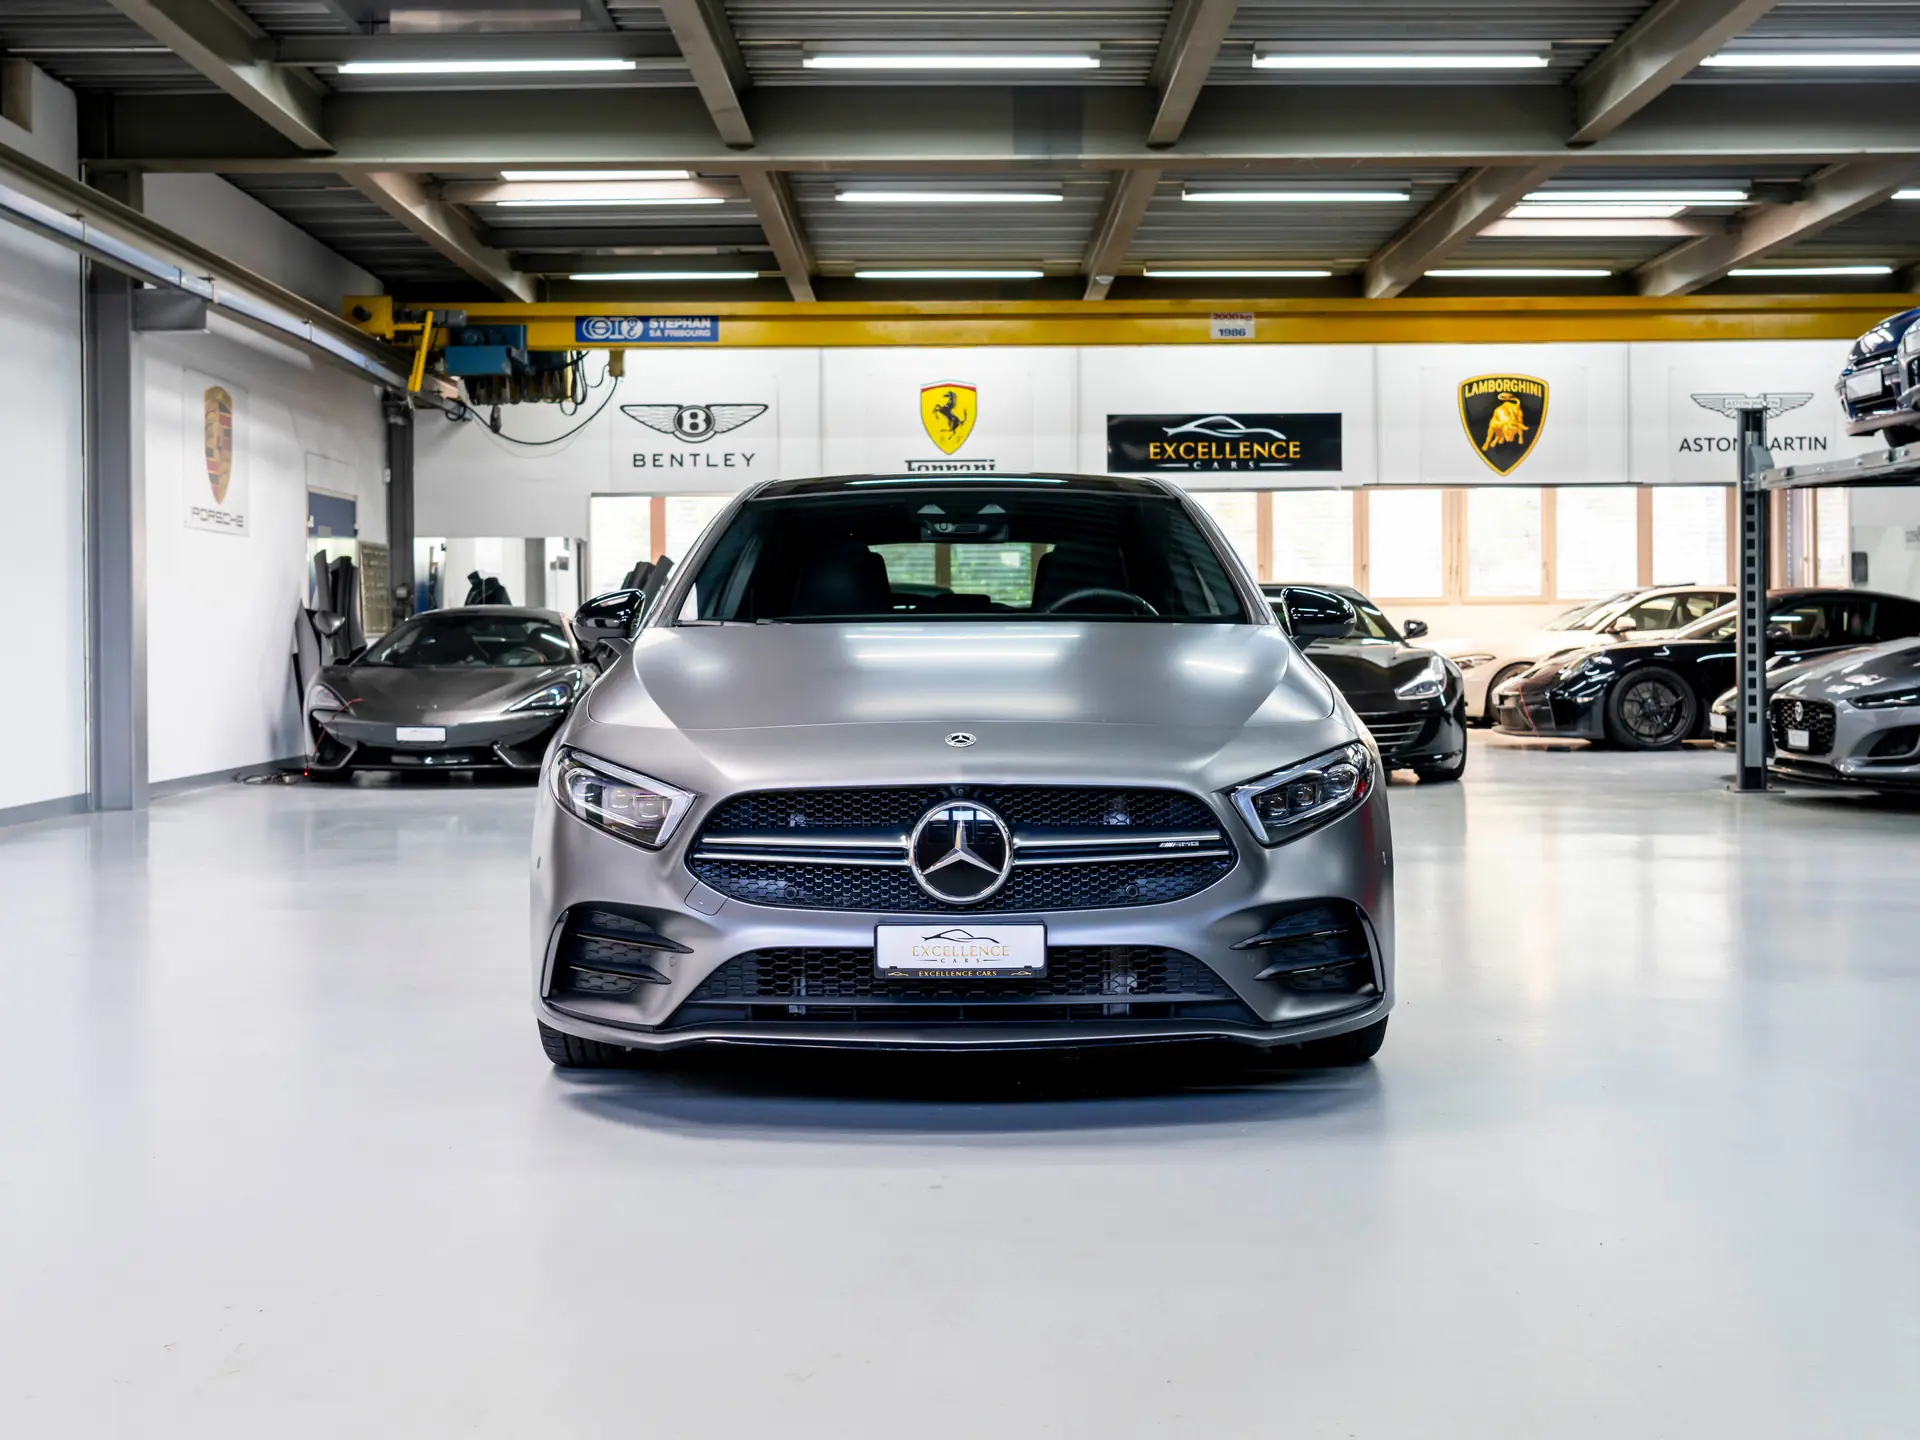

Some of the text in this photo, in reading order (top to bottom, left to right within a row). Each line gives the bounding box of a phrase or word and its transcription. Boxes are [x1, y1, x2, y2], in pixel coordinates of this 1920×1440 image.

[648, 318, 712, 329] STEPHAN
[664, 329, 712, 337] FRIBOURG
[1218, 327, 1246, 337] 1986
[1464, 379, 1543, 398] LAMBORGHINI
[1149, 441, 1301, 460] EXCELLENCE
[1769, 436, 1827, 452] ARTIN
[632, 453, 755, 468] BENTLEY
[1193, 461, 1255, 470] CARS
[191, 507, 244, 528] PORSCHE
[911, 945, 1011, 957] EXCELLENCE
